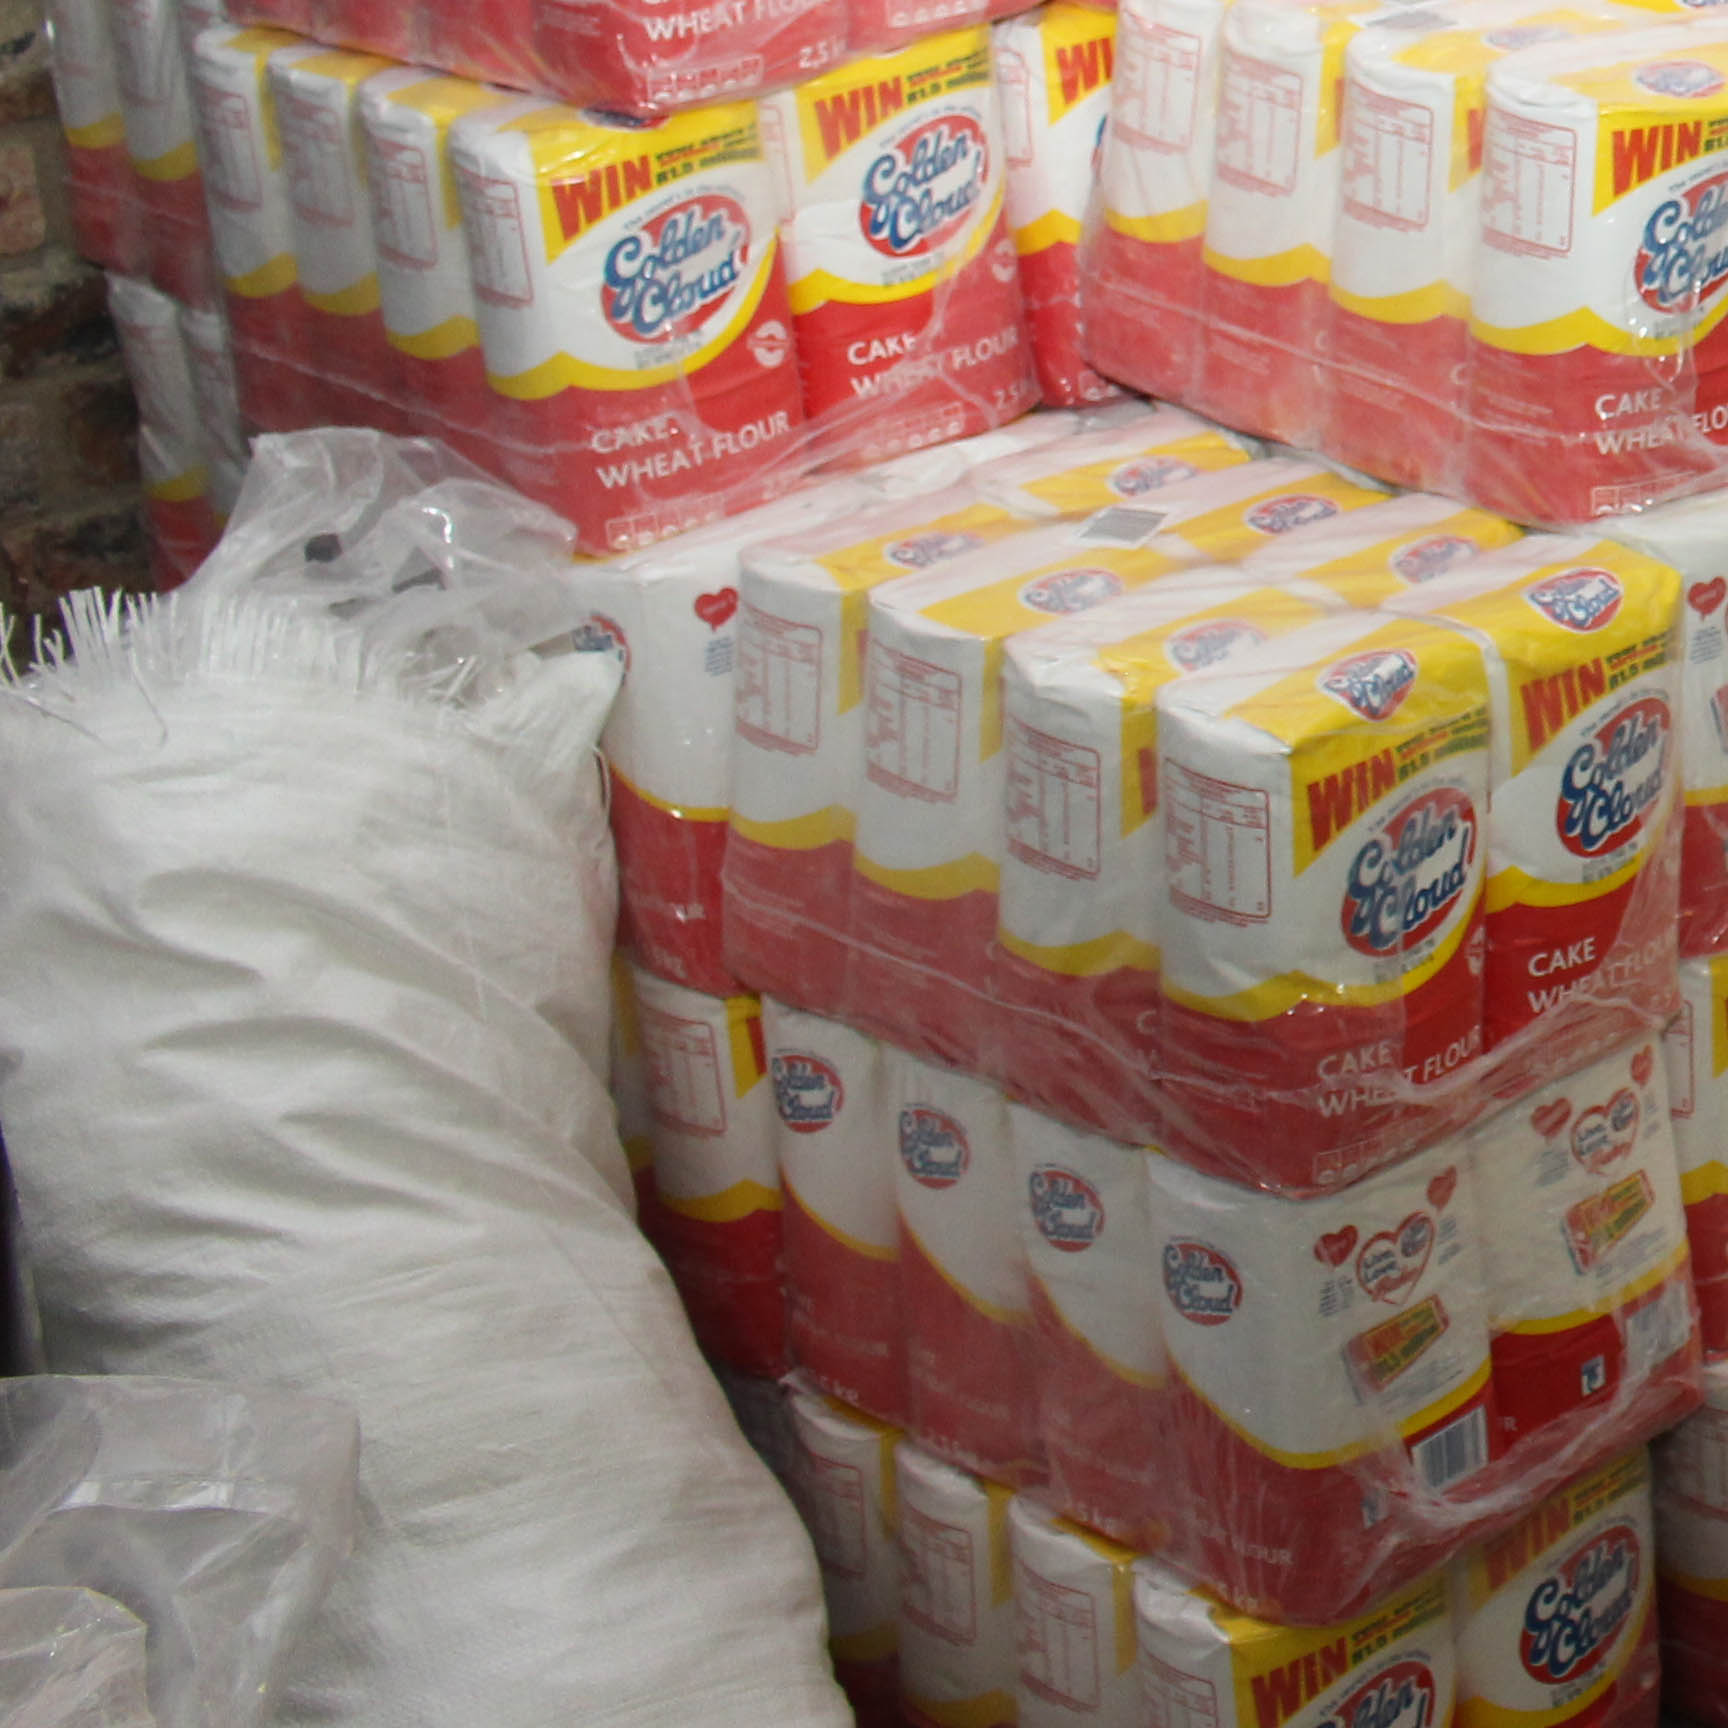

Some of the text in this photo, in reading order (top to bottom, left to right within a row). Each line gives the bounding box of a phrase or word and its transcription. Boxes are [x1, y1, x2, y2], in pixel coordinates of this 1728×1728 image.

[815, 77, 903, 160] WIN
[1612, 120, 1703, 200] WIN
[551, 155, 652, 240] WIN
[866, 131, 969, 234] Golden
[604, 203, 726, 319] Golden
[630, 228, 743, 334] Cloud
[596, 411, 791, 489] WHEAT FLOUR
[1594, 389, 1662, 421] CAKE
[1520, 656, 1604, 752] WIN
[1306, 748, 1397, 854] WIN
[1560, 711, 1658, 834] Golden
[1581, 753, 1664, 850] Cloud
[1347, 808, 1456, 936] Golden
[1368, 827, 1469, 950] Cloud
[1526, 936, 1598, 978] CAKE
[1316, 1039, 1392, 1079] CAKE
[1422, 1029, 1480, 1083] FLOUR
[1526, 1538, 1627, 1660] Golden
[1546, 1577, 1635, 1677] Cloud
